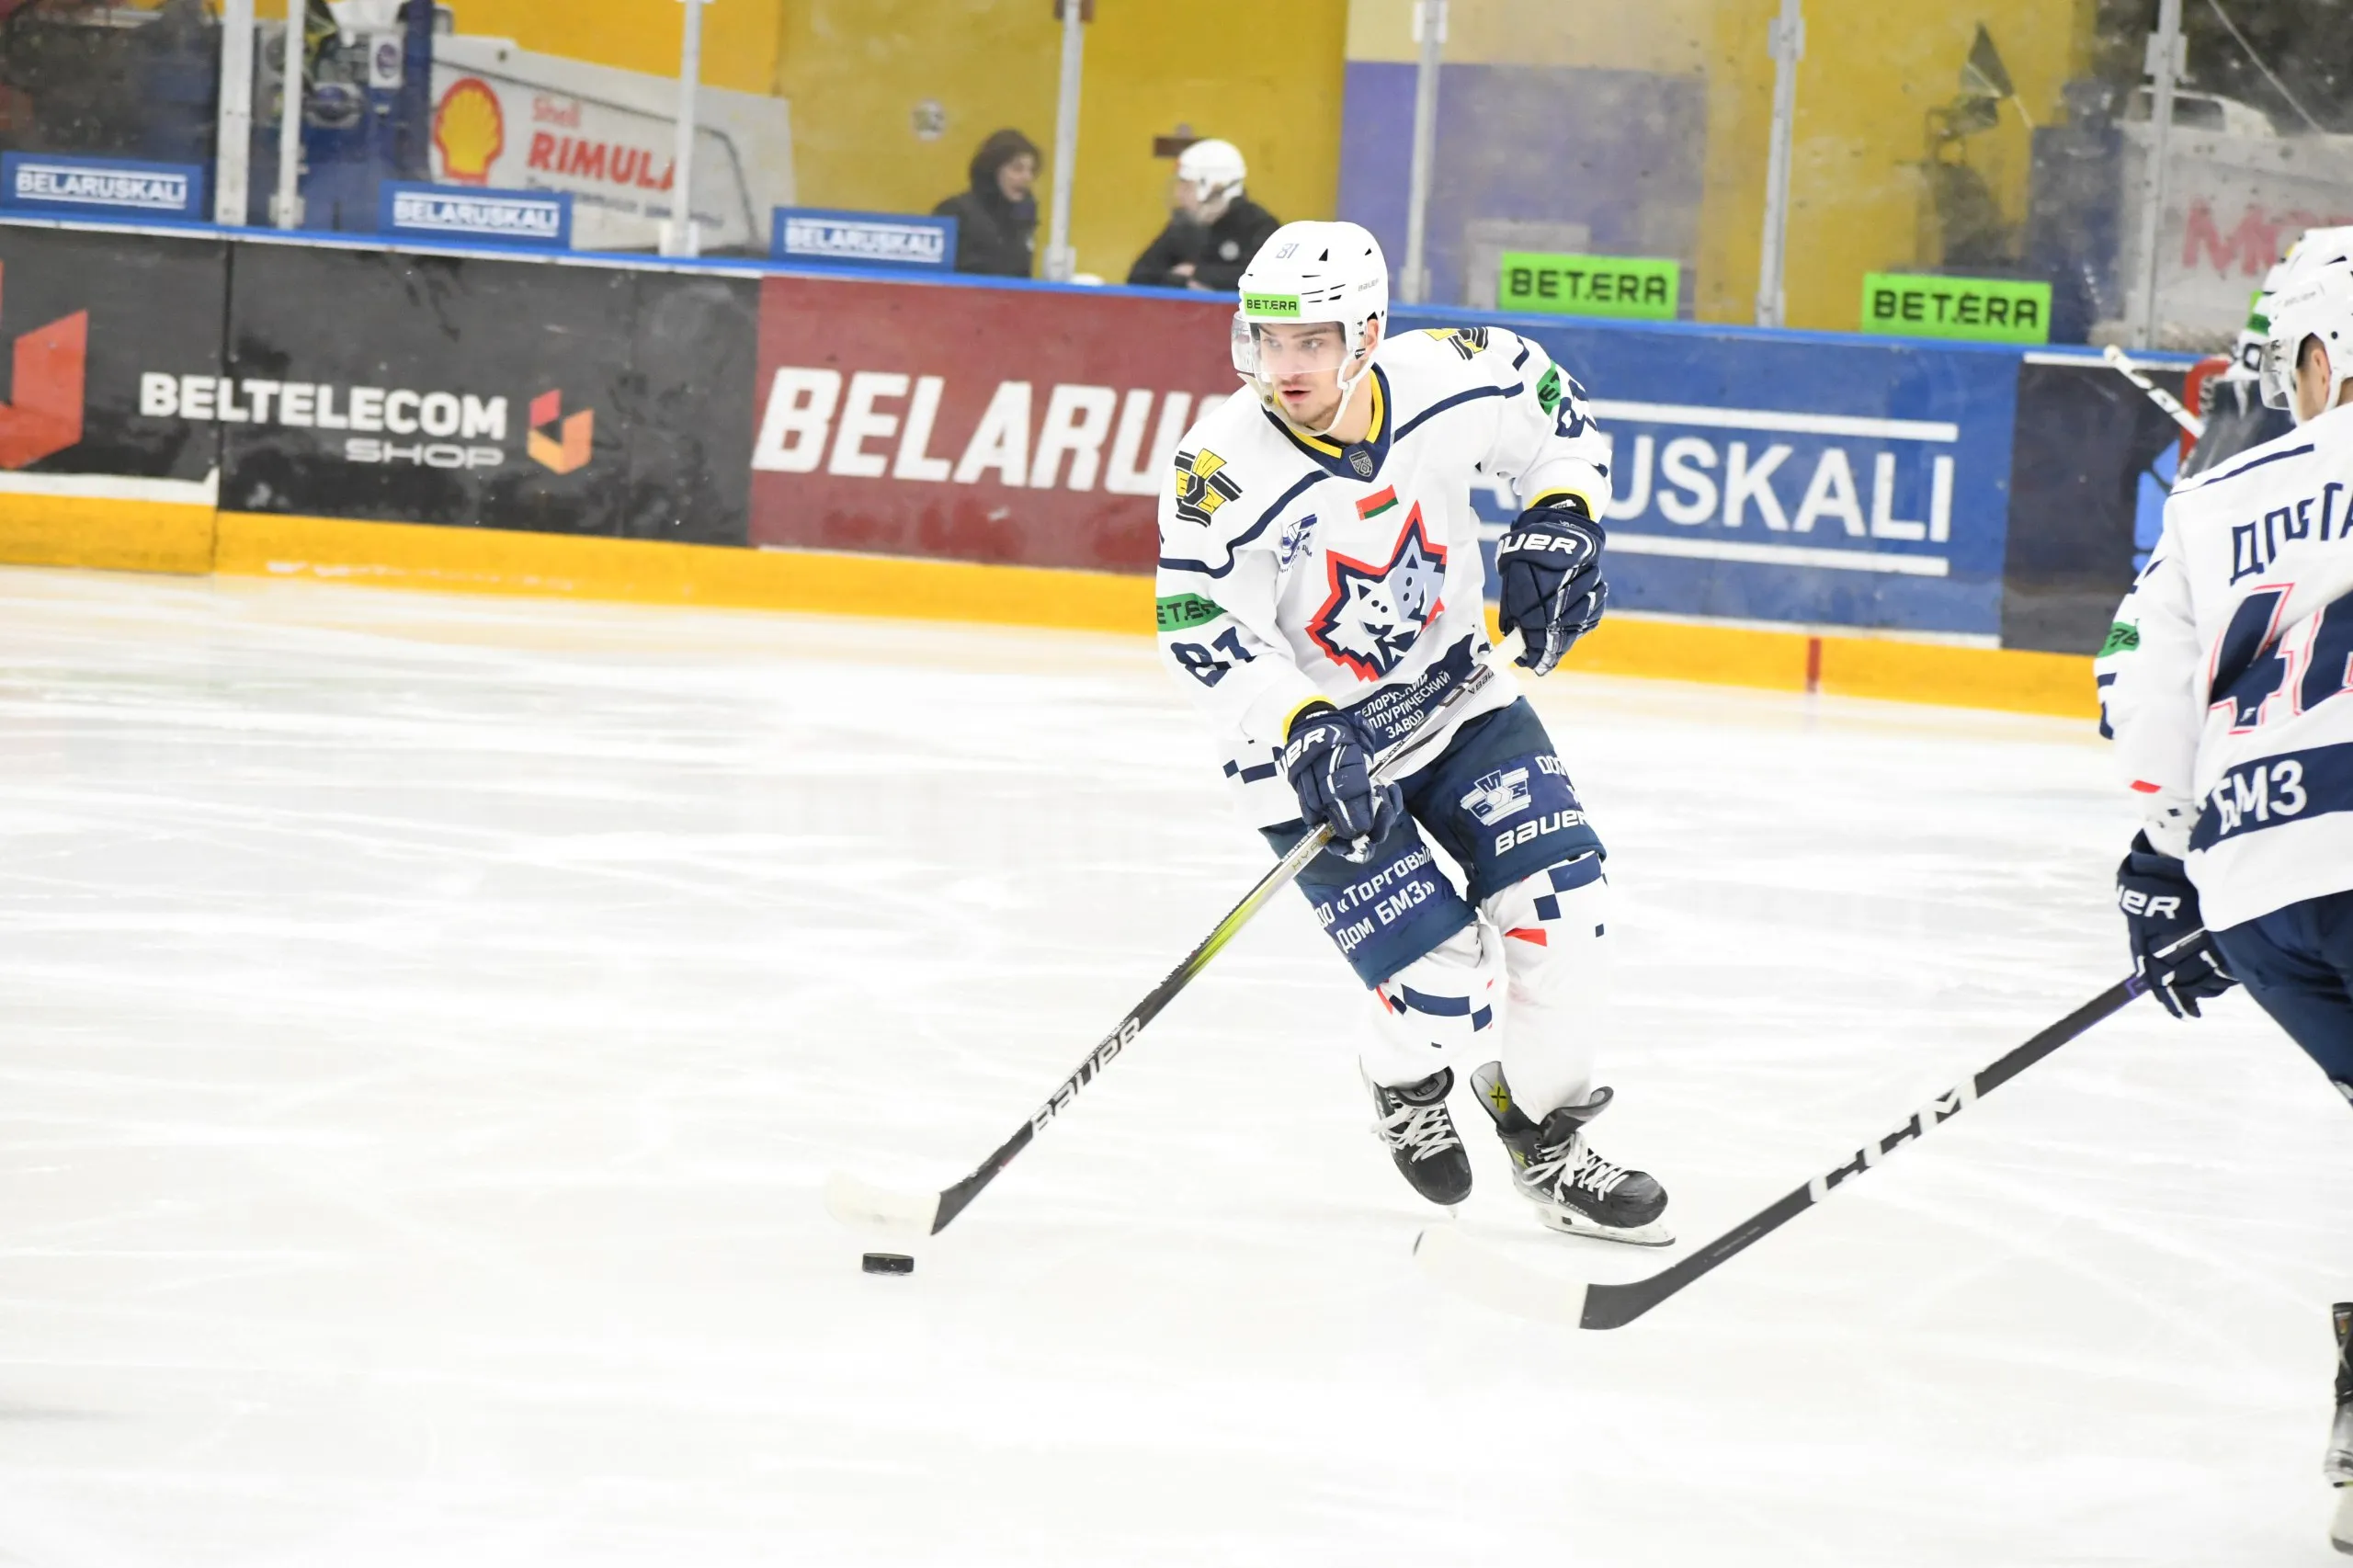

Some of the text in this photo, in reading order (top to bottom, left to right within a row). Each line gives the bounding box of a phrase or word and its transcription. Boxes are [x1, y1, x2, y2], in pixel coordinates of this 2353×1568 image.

[17, 170, 188, 201] BELARUSKALI
[393, 199, 559, 230] BELARUSKALI
[140, 372, 508, 440] BELTELECOM
[751, 366, 1230, 496] BELARU
[345, 437, 505, 468] SHOP
